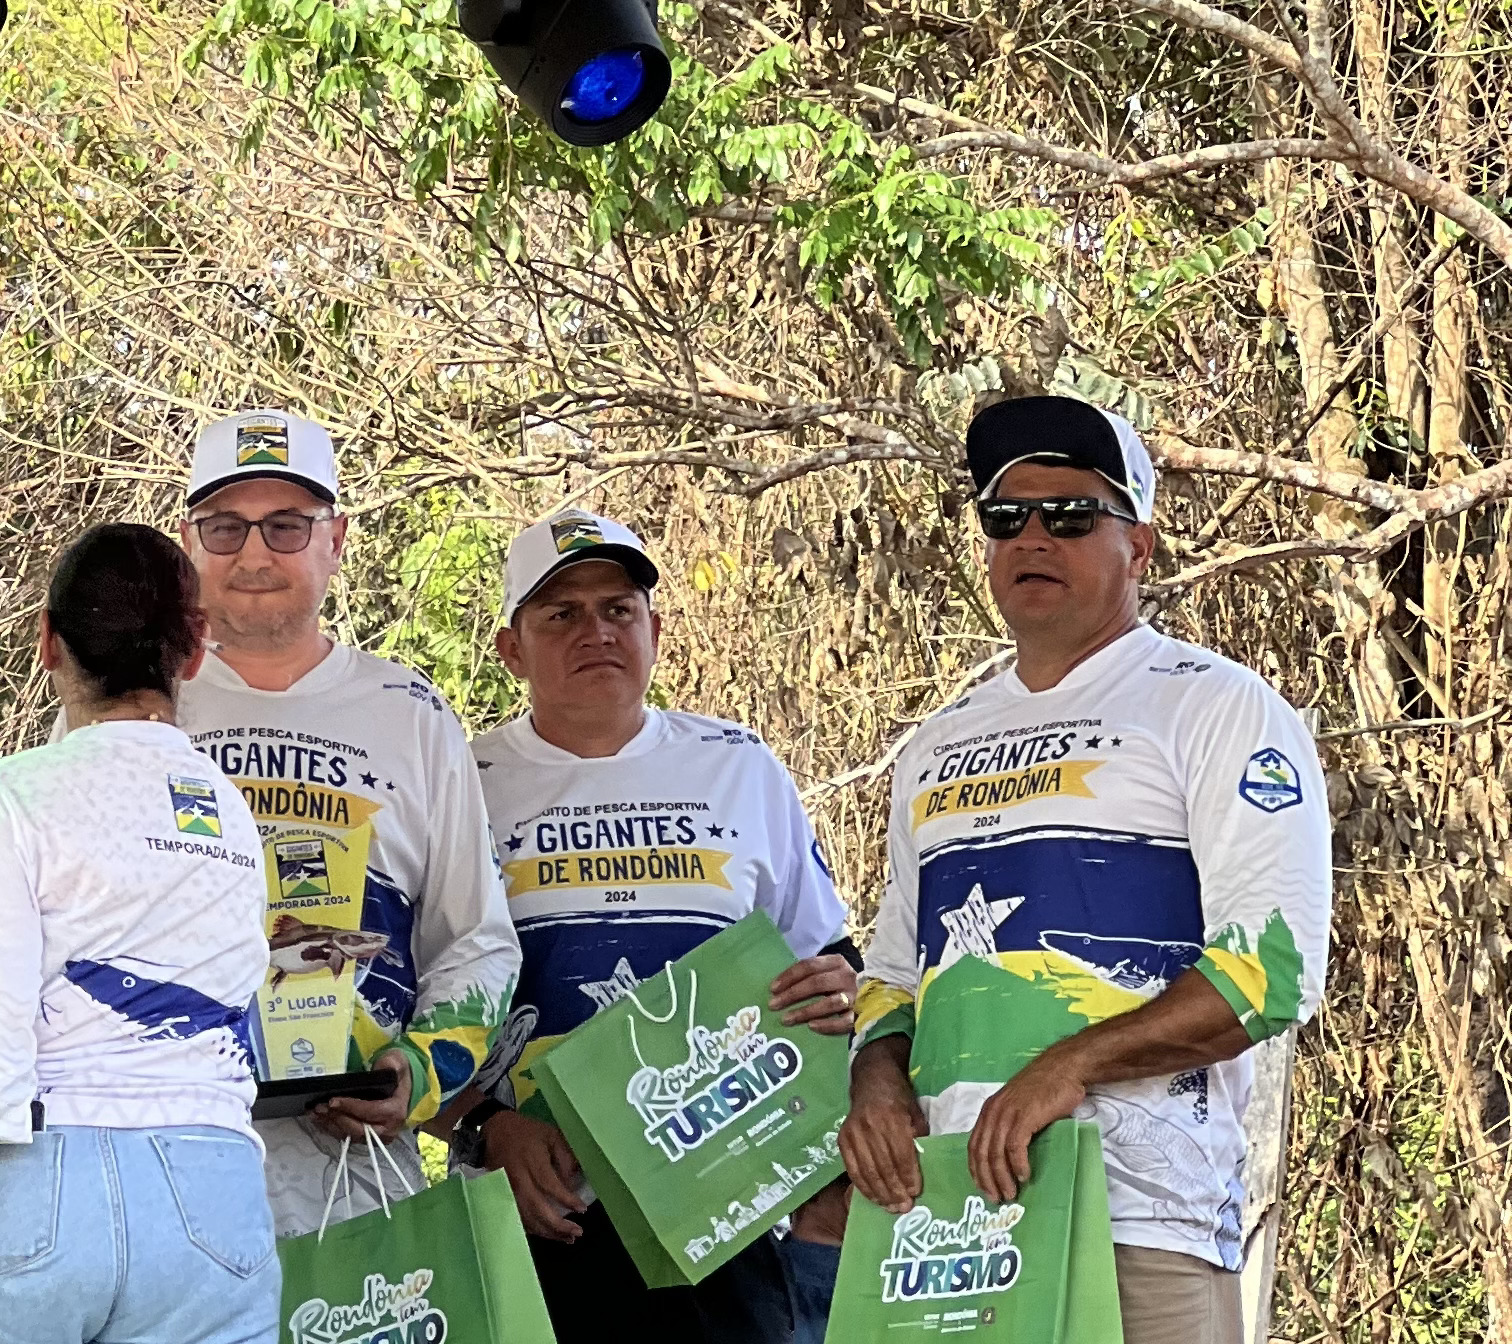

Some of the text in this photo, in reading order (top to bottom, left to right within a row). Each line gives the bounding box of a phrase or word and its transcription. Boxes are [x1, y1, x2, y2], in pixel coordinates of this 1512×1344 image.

[227, 727, 245, 738] DE
[249, 727, 293, 741] PESCA
[297, 733, 368, 760] ESPORTIVA
[984, 730, 1001, 743] DE
[937, 733, 1077, 783] GIGANTES
[243, 781, 349, 825] ONDÔNIA
[925, 767, 1062, 818] DE RONDÔNIA
[573, 802, 711, 817] DE PESCA ESPORTIVA
[973, 814, 1001, 828] 2024
[536, 815, 697, 854] GIGANTES
[145, 837, 256, 870] TEMPORADA 2024
[538, 847, 706, 886] DE RONDÔNIA
[324, 895, 351, 906] 2024
[604, 890, 637, 903] 2024
[287, 994, 338, 1011] LUGAR
[646, 1038, 802, 1162] TURISMO
[880, 1246, 1022, 1303] TURISMO
